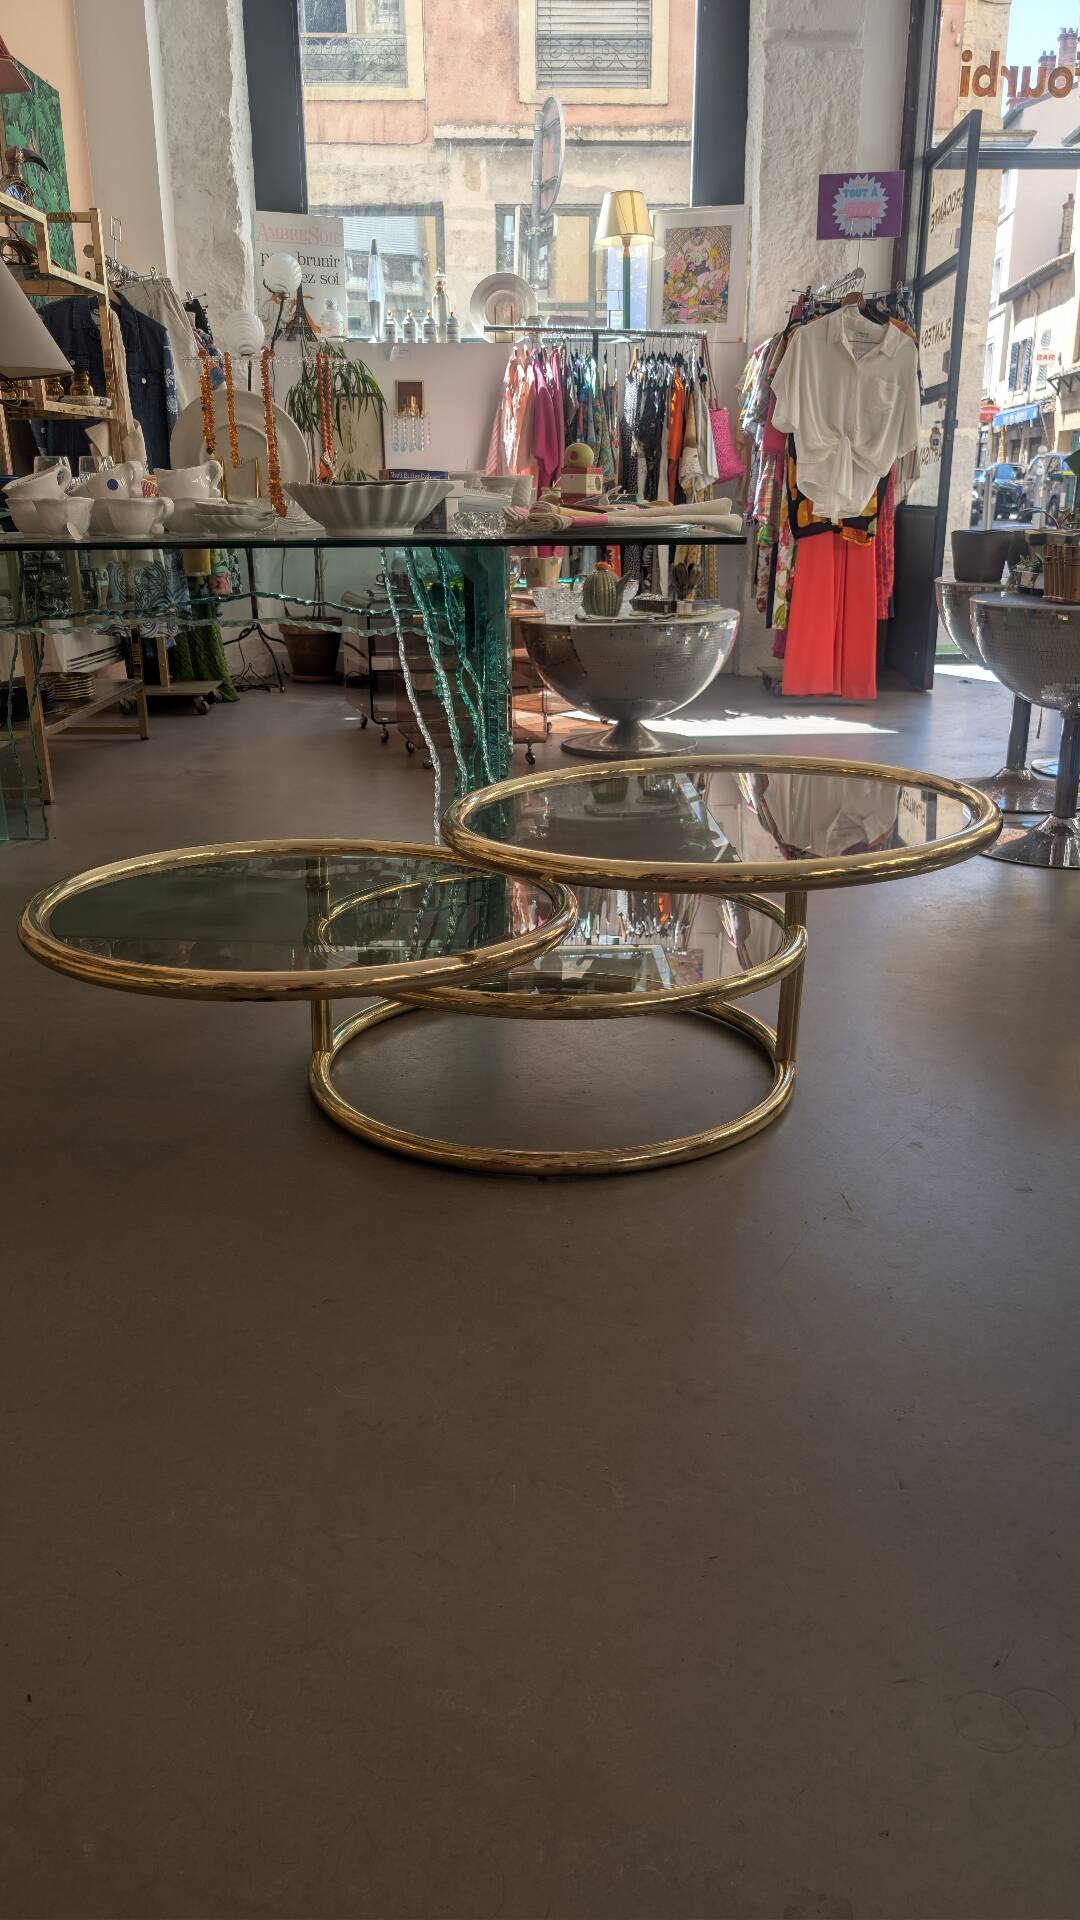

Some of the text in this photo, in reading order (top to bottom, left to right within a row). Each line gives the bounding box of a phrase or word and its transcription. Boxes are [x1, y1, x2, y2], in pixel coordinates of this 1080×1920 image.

[842, 188, 868, 198] TOUT
[297, 251, 340, 268] brunir
[319, 272, 340, 285] soi
[1036, 353, 1056, 361] BAR
